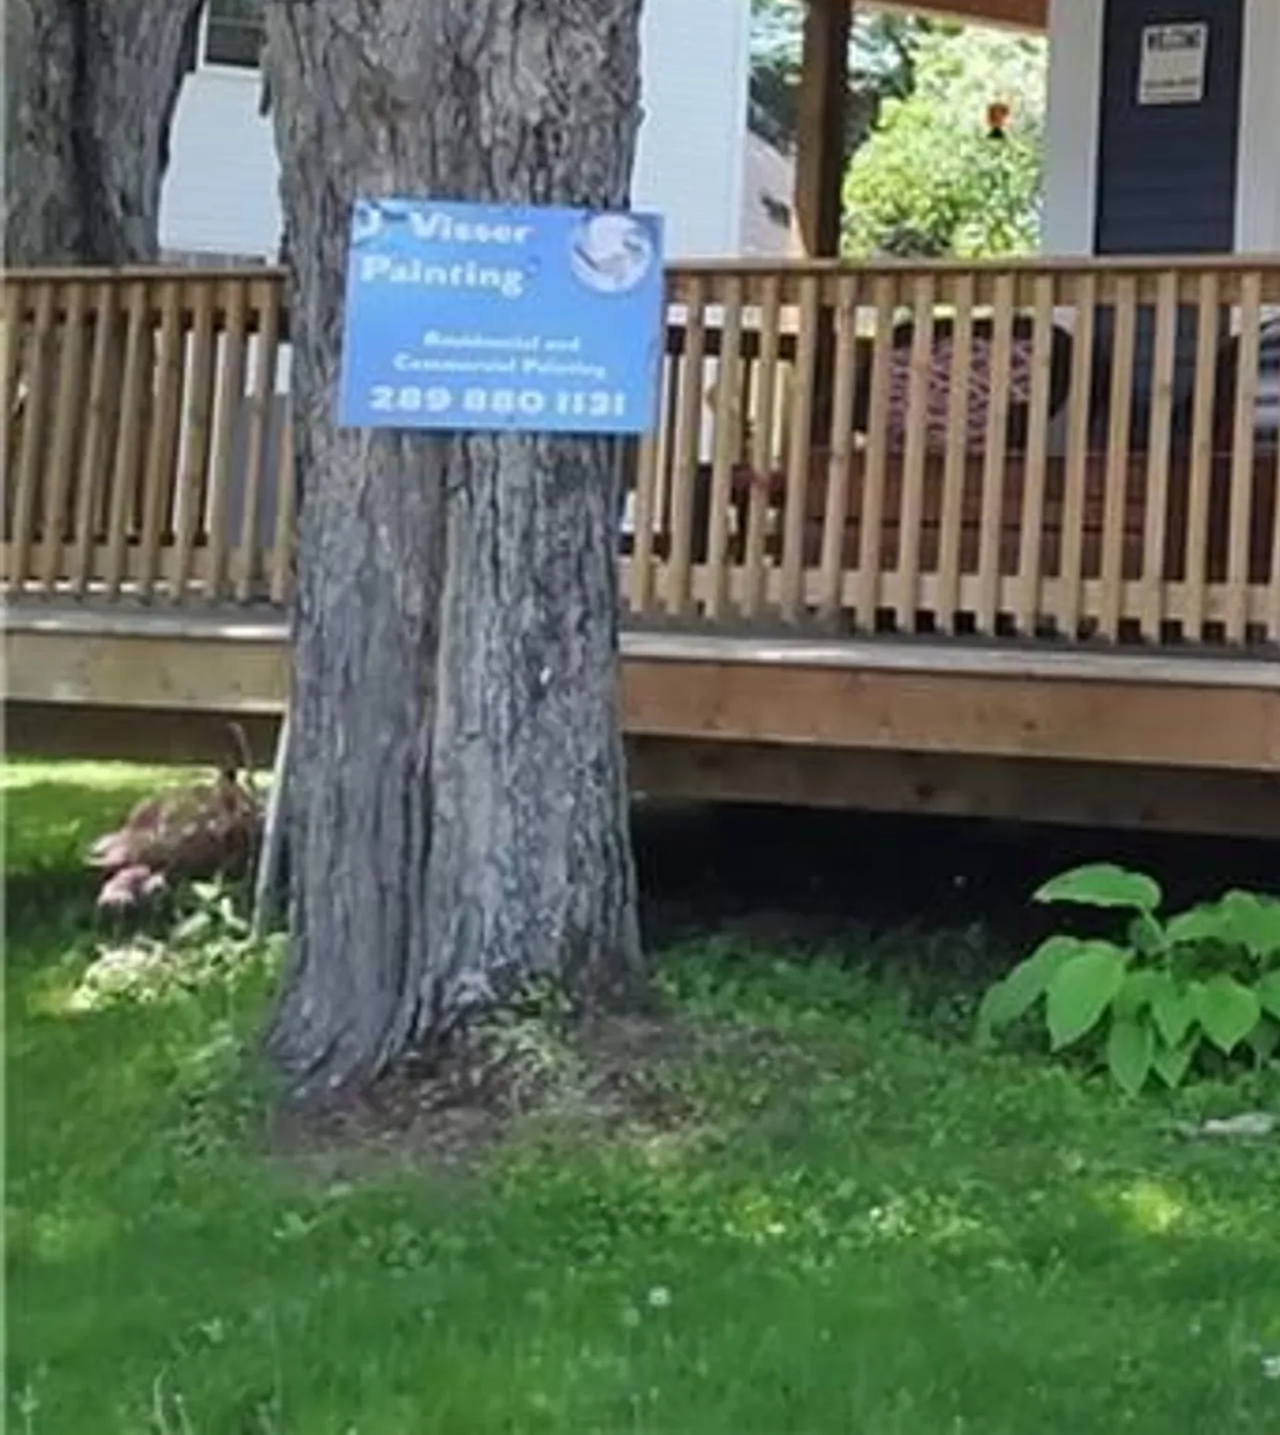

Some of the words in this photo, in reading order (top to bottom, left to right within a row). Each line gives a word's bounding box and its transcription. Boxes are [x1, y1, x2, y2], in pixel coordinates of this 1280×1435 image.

[409, 212, 531, 243] Visser
[361, 255, 523, 298] Painting
[424, 332, 539, 351] Residential
[546, 336, 579, 352] and
[394, 353, 515, 374] Commercial
[522, 358, 606, 379] Painting
[370, 387, 452, 412] 289
[463, 389, 544, 413] 880
